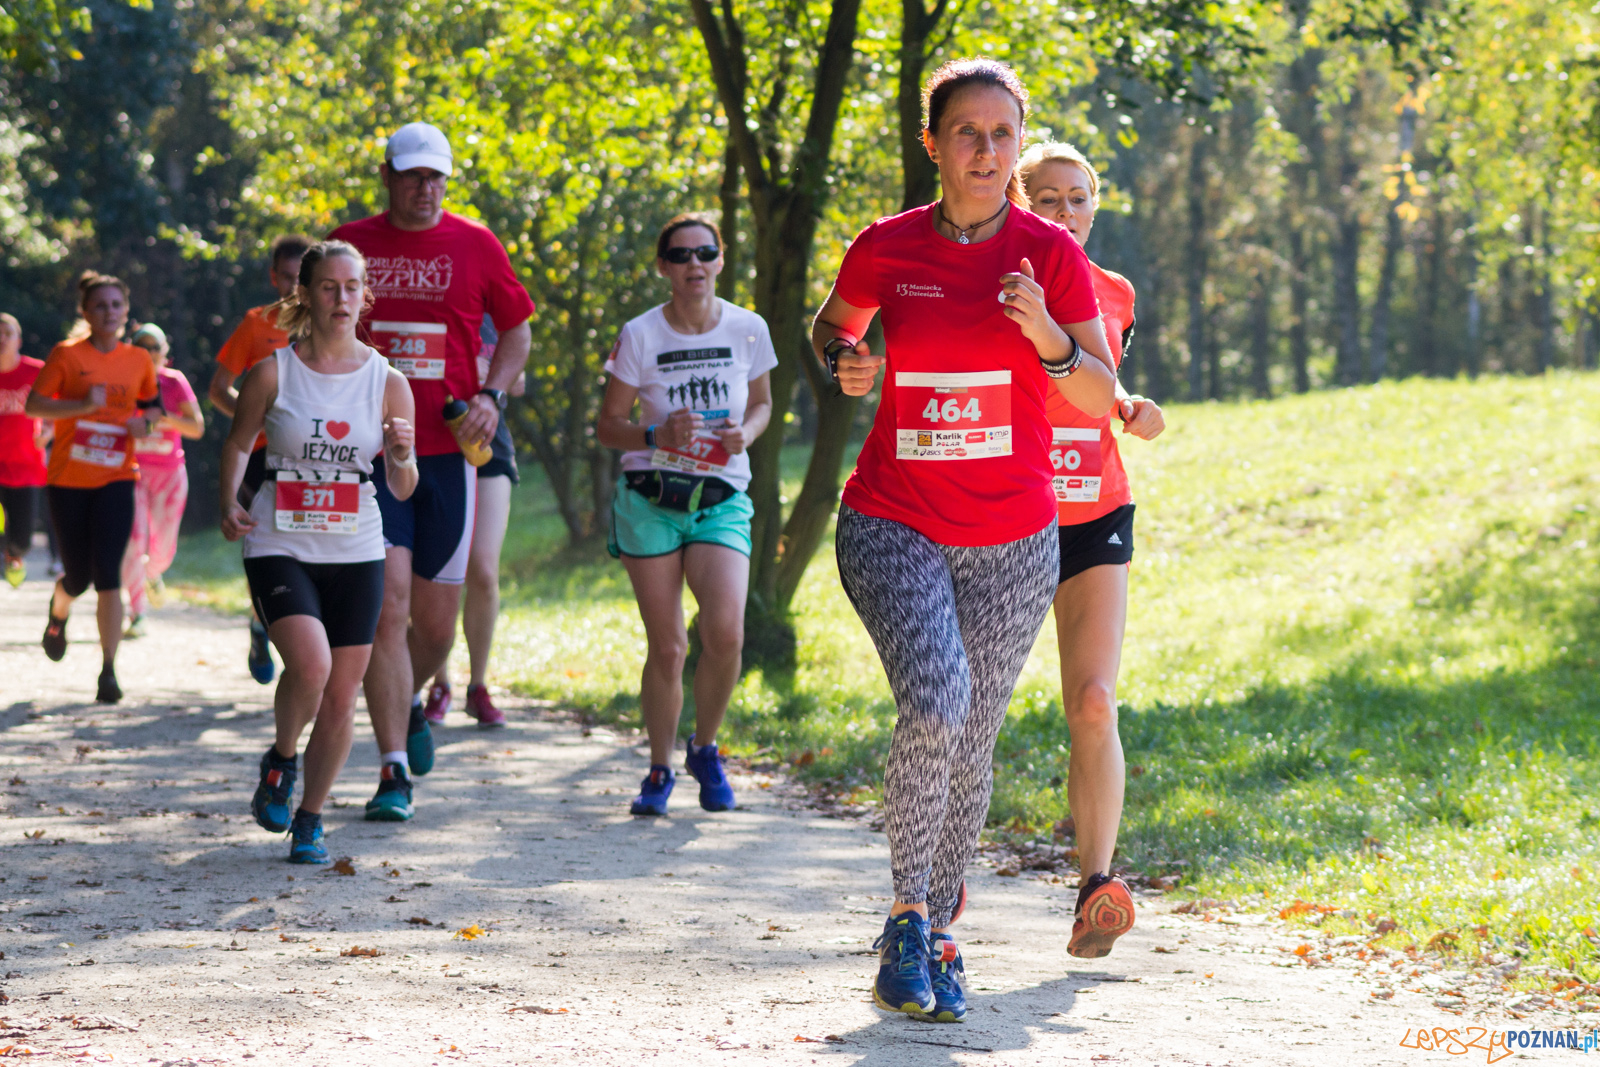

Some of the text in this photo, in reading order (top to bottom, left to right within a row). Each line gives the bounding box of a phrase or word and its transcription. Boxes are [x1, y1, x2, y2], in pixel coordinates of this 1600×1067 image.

[367, 255, 437, 271] DRUŻYNA
[367, 269, 453, 290] SZPIKU
[896, 283, 908, 297] 13
[390, 337, 426, 355] 248
[687, 349, 719, 359] BIEG
[922, 398, 981, 422] 464
[311, 418, 324, 438] I
[302, 440, 359, 463] JEŻYCE
[302, 488, 335, 507] 371
